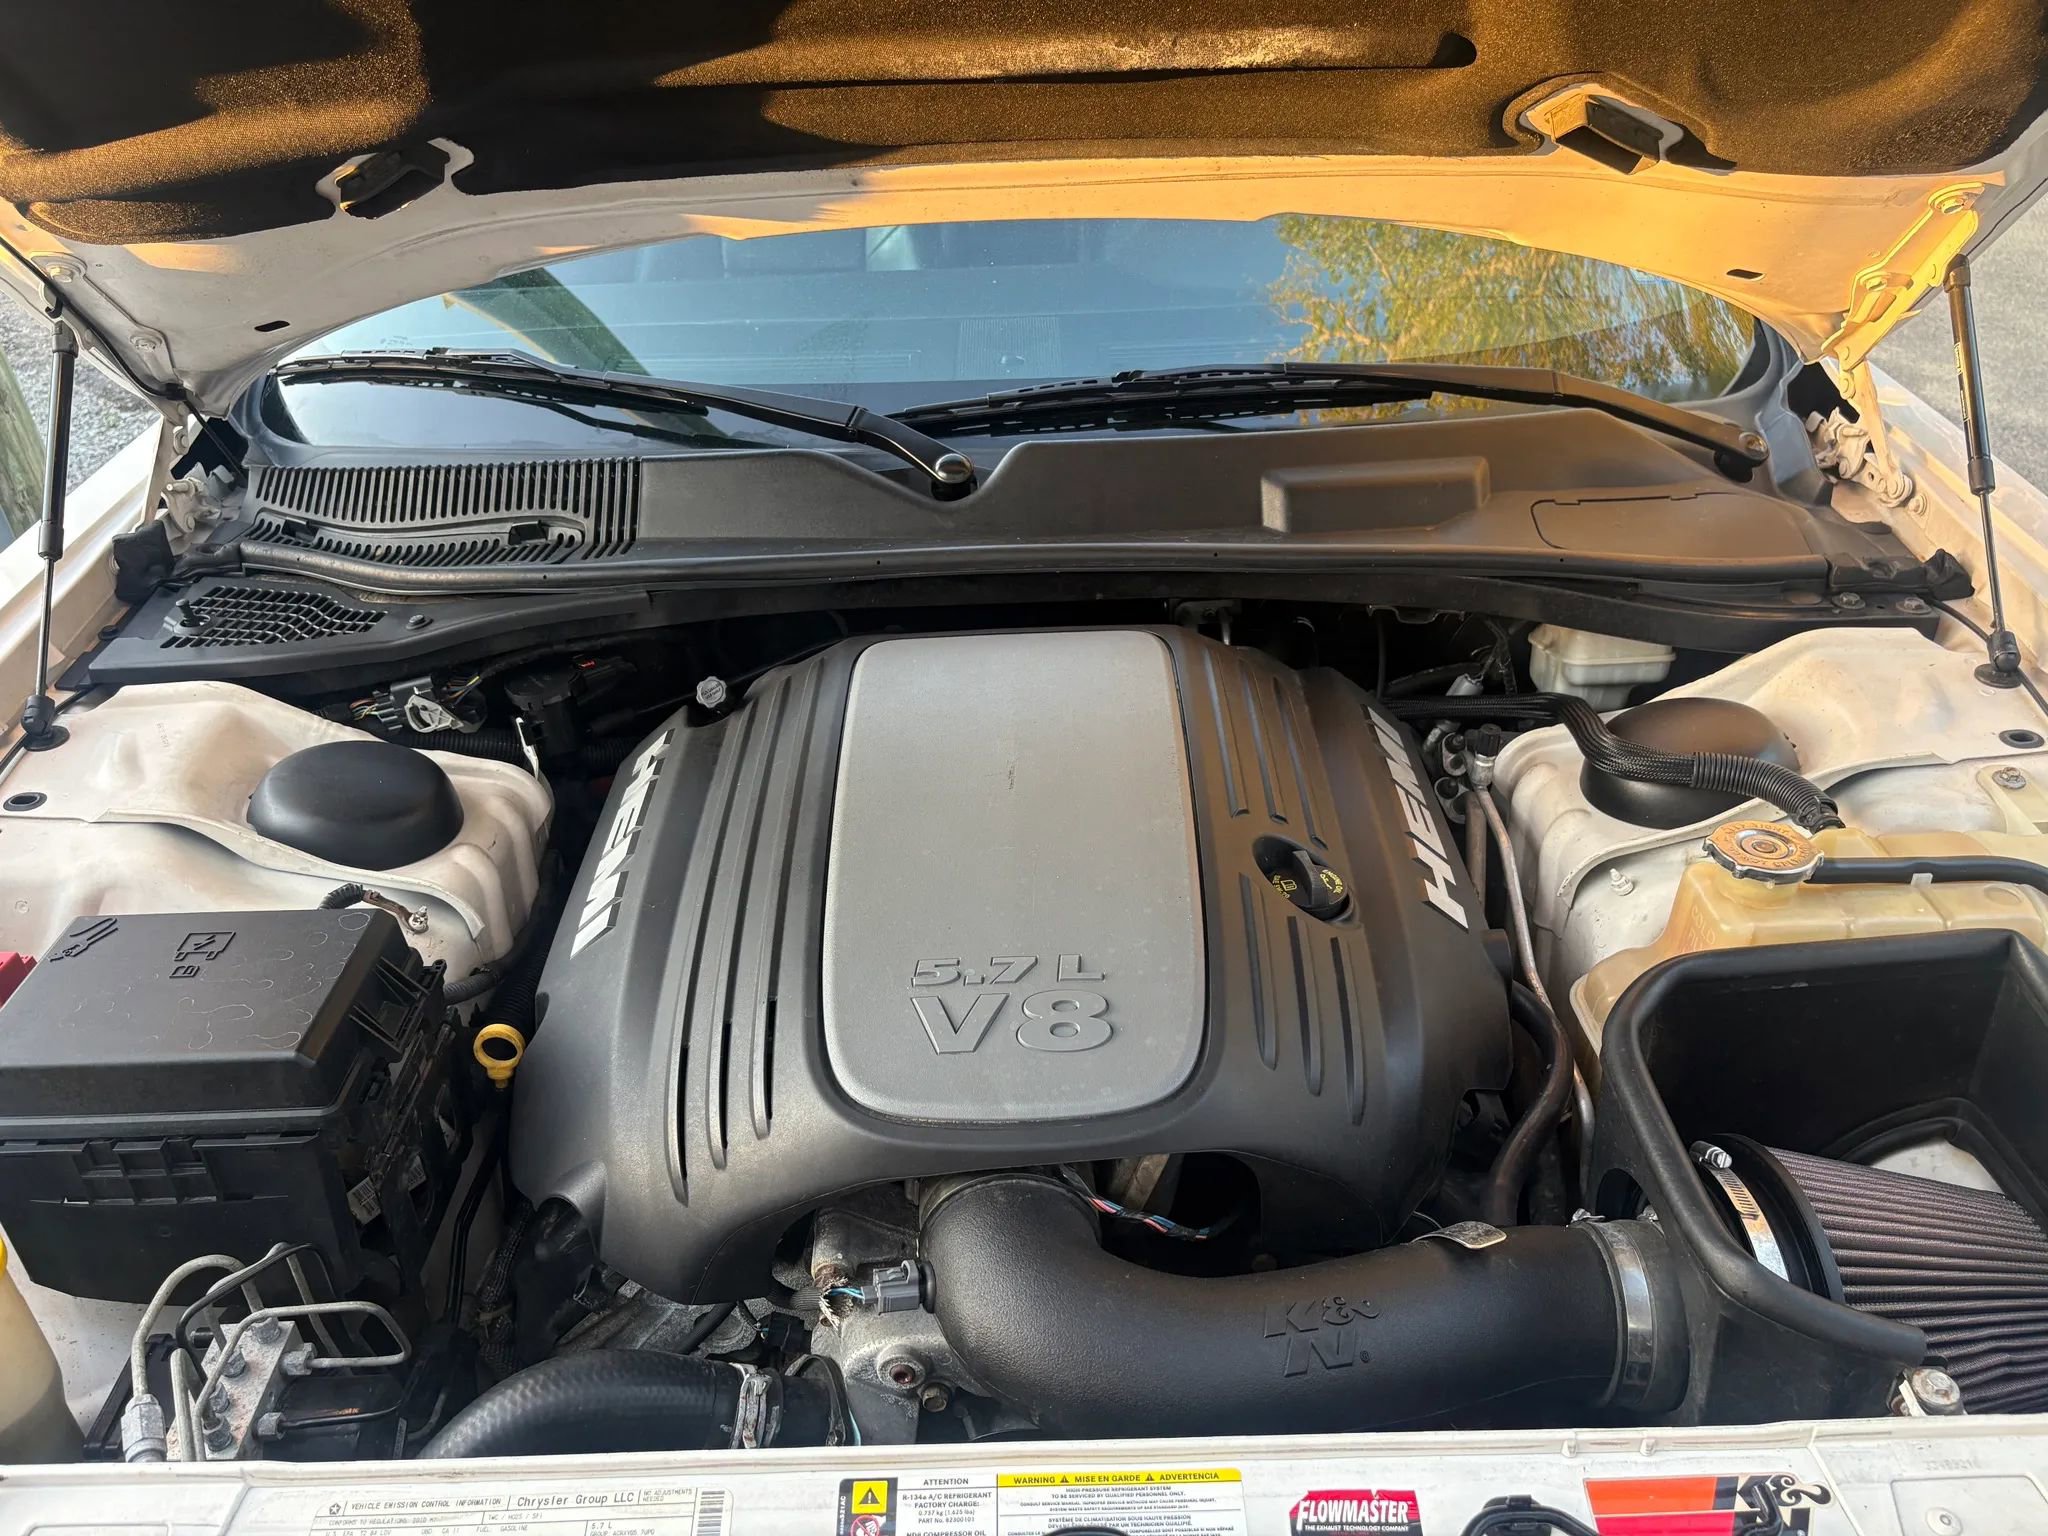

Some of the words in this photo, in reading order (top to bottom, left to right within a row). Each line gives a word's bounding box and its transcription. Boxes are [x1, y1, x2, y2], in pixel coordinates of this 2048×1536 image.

[1361, 704, 1469, 933] HEMI
[569, 727, 675, 961] HEMI
[910, 954, 1038, 986] 5.7
[1056, 953, 1106, 982] L
[909, 988, 1114, 1055] V8
[923, 1478, 969, 1486] ATTENTION
[1013, 1476, 1056, 1484] WARNING
[1074, 1475, 1097, 1483] MISE
[1097, 1475, 1110, 1483] EN
[1111, 1473, 1141, 1482] GARDE
[1159, 1472, 1219, 1481] ADVERTENCIA
[653, 1488, 692, 1496] ADJUSTMENTS
[902, 1493, 927, 1501] R-134a
[928, 1493, 943, 1501] A/C
[944, 1491, 993, 1500] REFRIGERANT
[351, 1502, 381, 1510] VEHICLE
[383, 1500, 418, 1509] EMISSION
[421, 1500, 451, 1508] CONTROL
[455, 1498, 502, 1507] INFORMATION
[517, 1496, 569, 1510] Chrysler
[575, 1494, 608, 1507] Group
[613, 1492, 634, 1503] LLC
[914, 1501, 947, 1509] FACTORY
[948, 1500, 980, 1508] CHARGE:
[1296, 1499, 1410, 1531] FLOWMASTER
[1343, 1524, 1381, 1532] TECHNOLOGY
[1381, 1524, 1409, 1532] COMPANY
